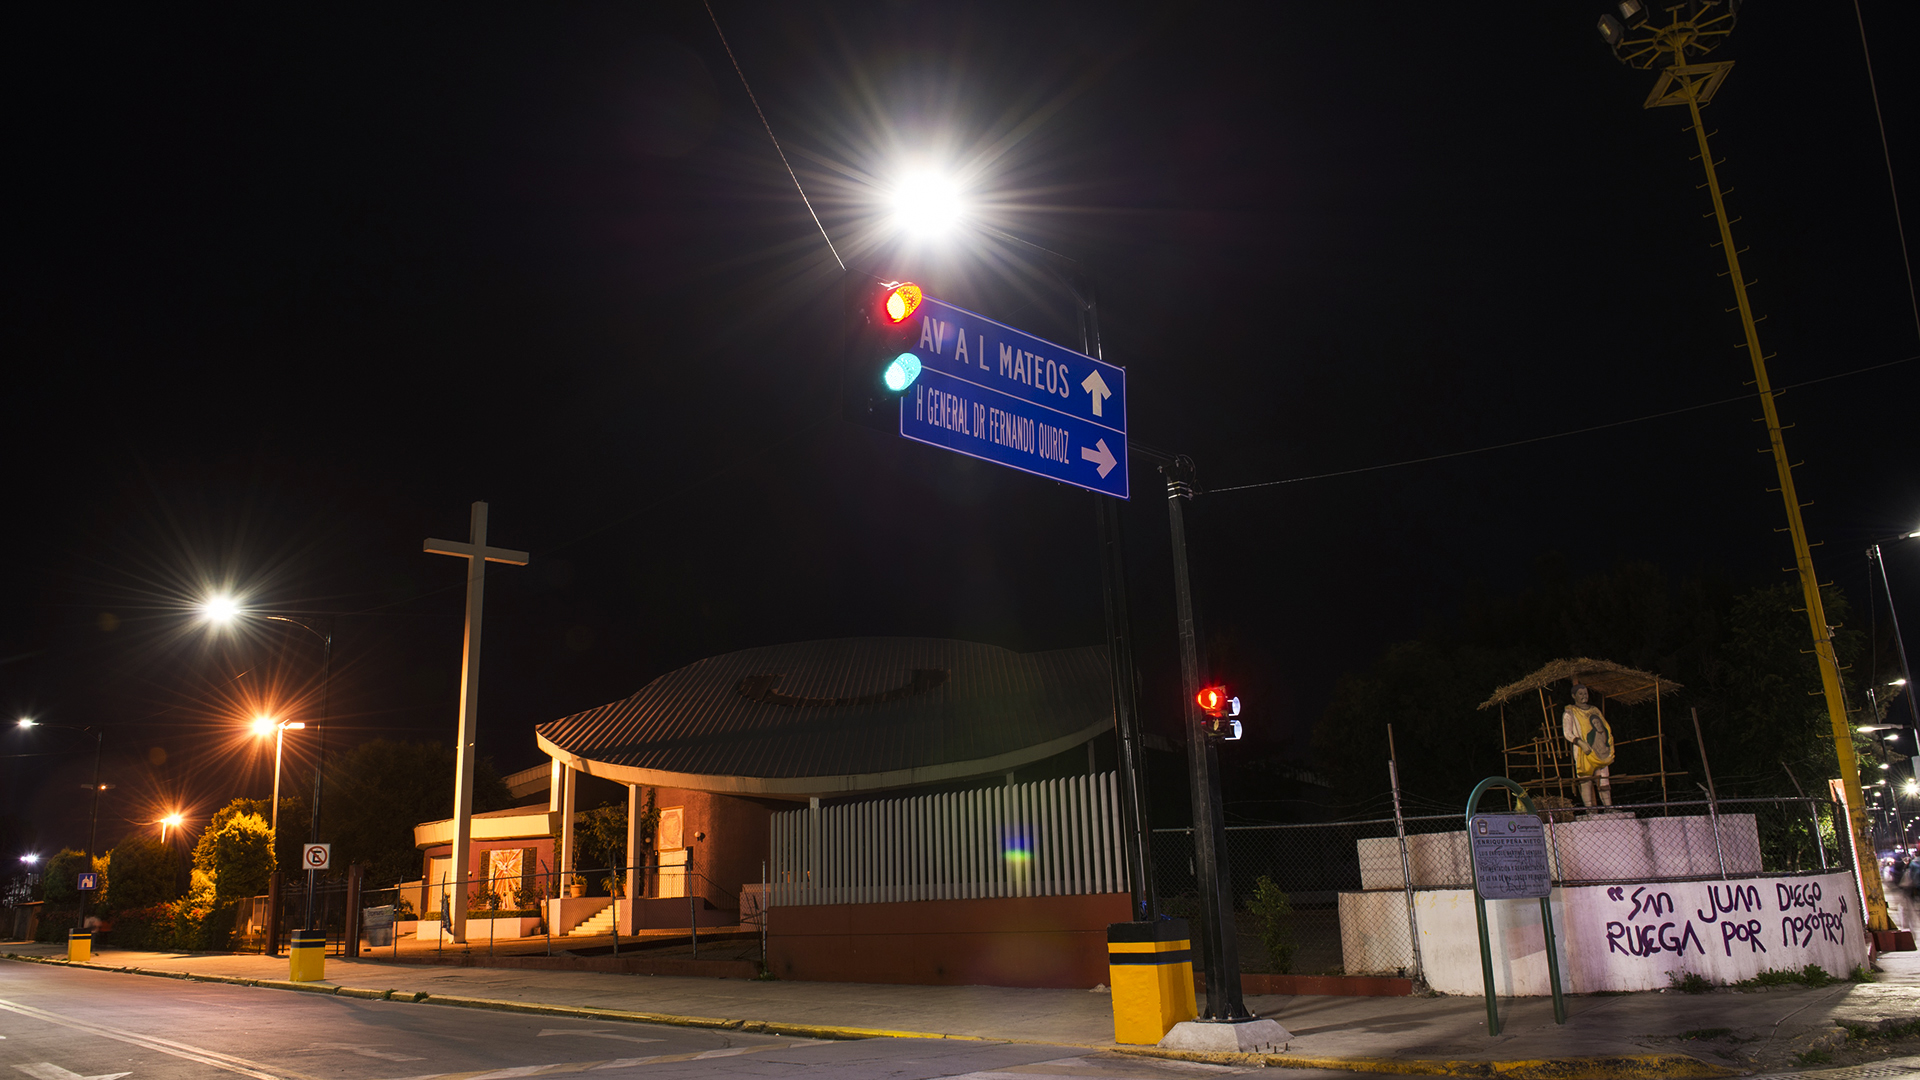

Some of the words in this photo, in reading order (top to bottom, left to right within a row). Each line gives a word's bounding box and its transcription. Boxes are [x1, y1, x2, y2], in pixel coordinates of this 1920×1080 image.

[920, 315, 945, 355] AV
[955, 328, 969, 364] A
[979, 335, 990, 371] L
[1000, 342, 1070, 398] MATEOS
[916, 384, 923, 421] H
[927, 387, 970, 436] GENERAL
[973, 402, 986, 441] DR
[989, 406, 1035, 455] FERNANDO
[1038, 421, 1070, 465] QUIROZ
[1697, 884, 1762, 923] JUAN
[1776, 882, 1822, 912] DIEGO
[1606, 920, 1706, 957] RUEGA
[1721, 919, 1767, 956] POR
